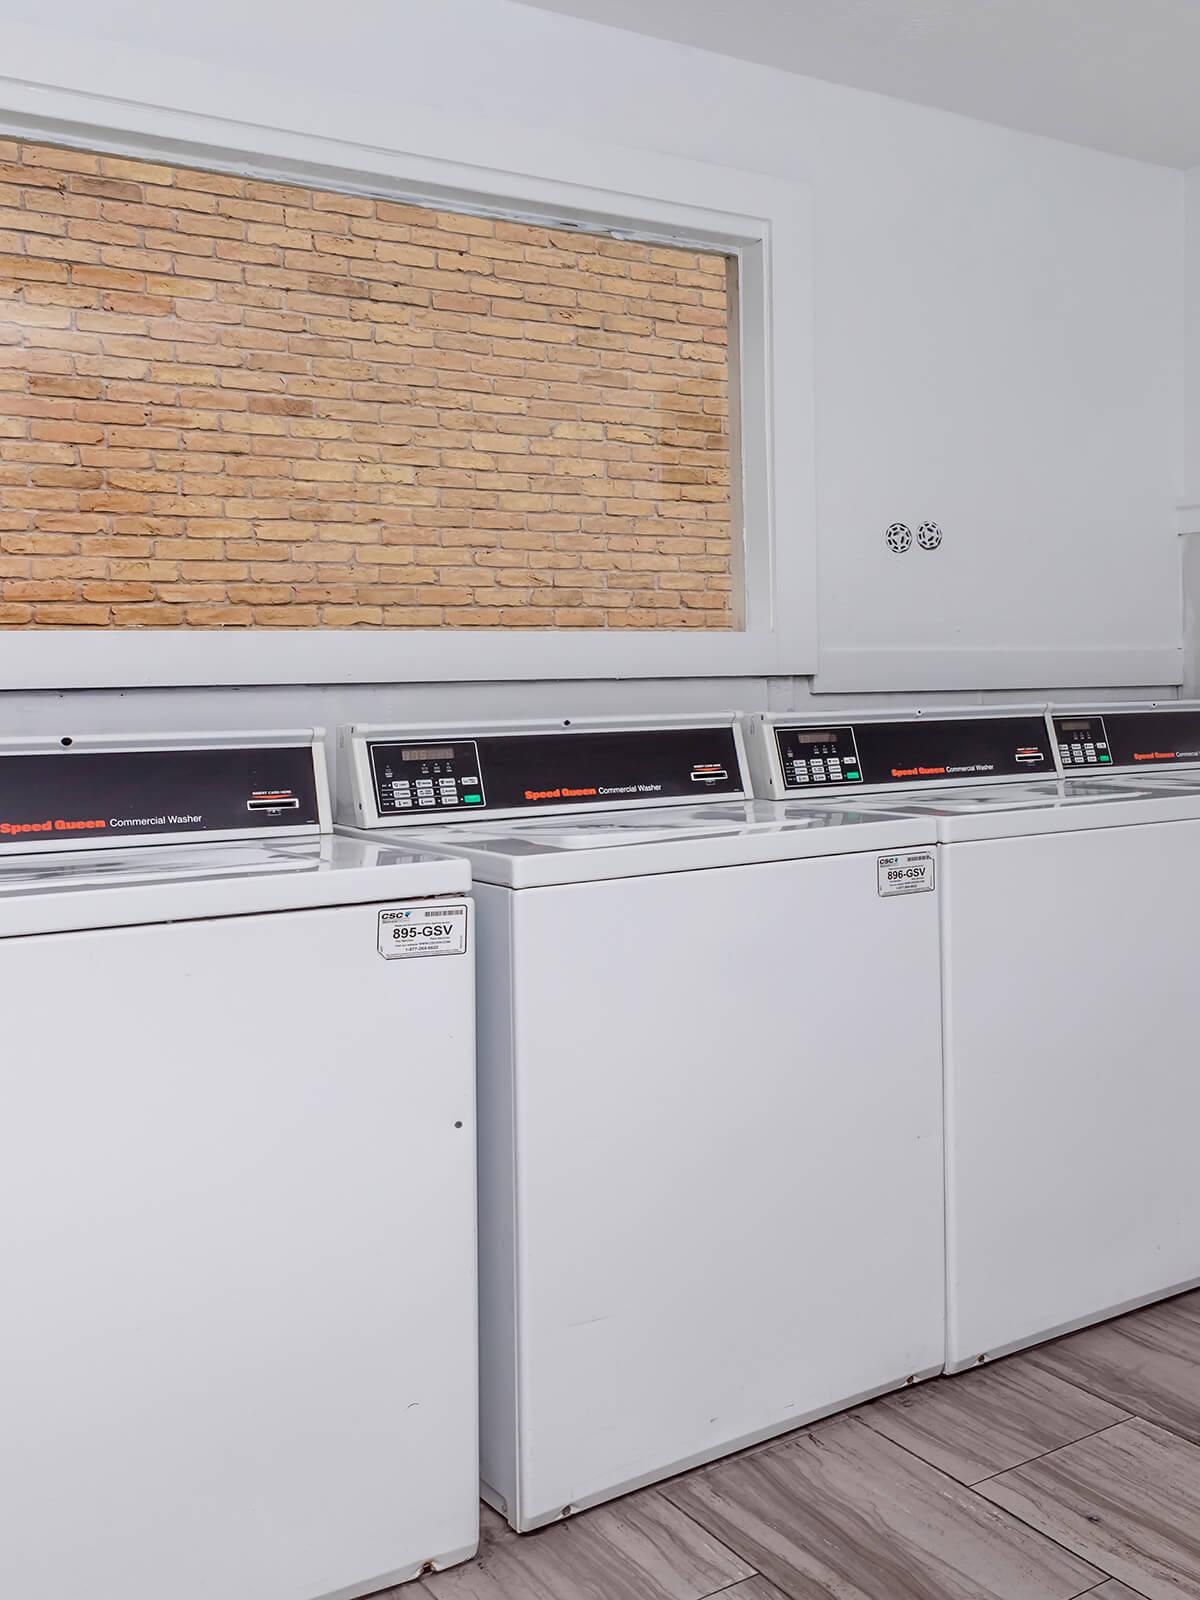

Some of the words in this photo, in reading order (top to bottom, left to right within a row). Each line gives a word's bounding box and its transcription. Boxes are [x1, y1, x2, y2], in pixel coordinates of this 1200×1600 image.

[891, 767, 918, 777] Speed
[524, 789, 560, 800] Speed
[561, 787, 597, 797] Queen
[598, 784, 637, 794] Commercial
[638, 783, 662, 792] Washer
[0, 821, 52, 835] Speed
[54, 819, 106, 831] Queen
[109, 816, 166, 828] Commercial
[167, 814, 203, 824] Washer
[887, 867, 926, 880] 896-GSV
[381, 912, 404, 920] CSC
[393, 924, 453, 939] 895-GSV
